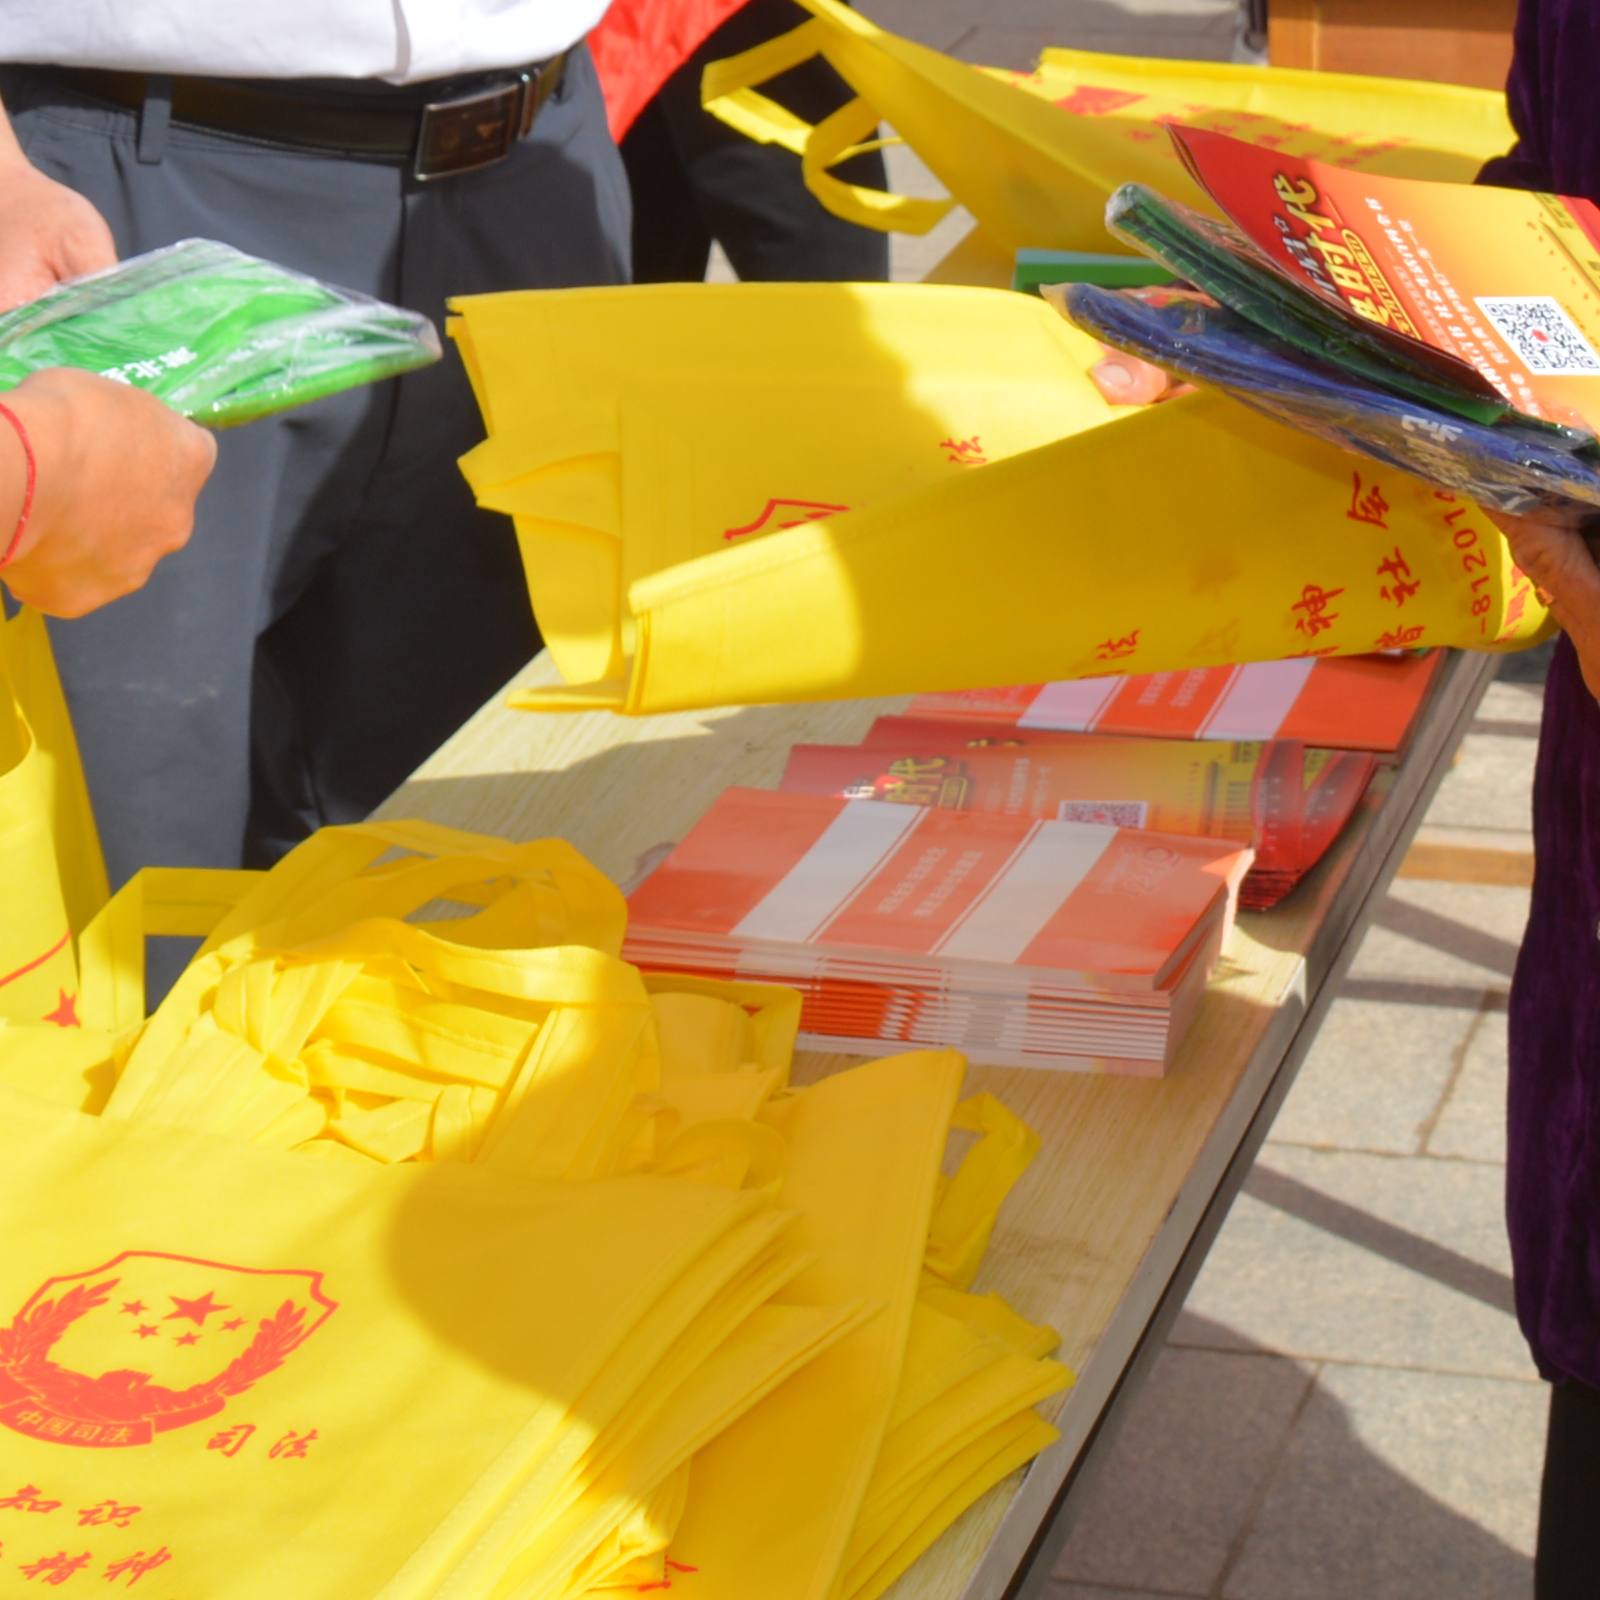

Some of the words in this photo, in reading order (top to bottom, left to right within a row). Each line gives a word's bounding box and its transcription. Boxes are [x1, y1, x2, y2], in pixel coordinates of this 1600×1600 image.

[14, 1409, 134, 1444] 中国司法
[206, 1423, 319, 1459] 司法
